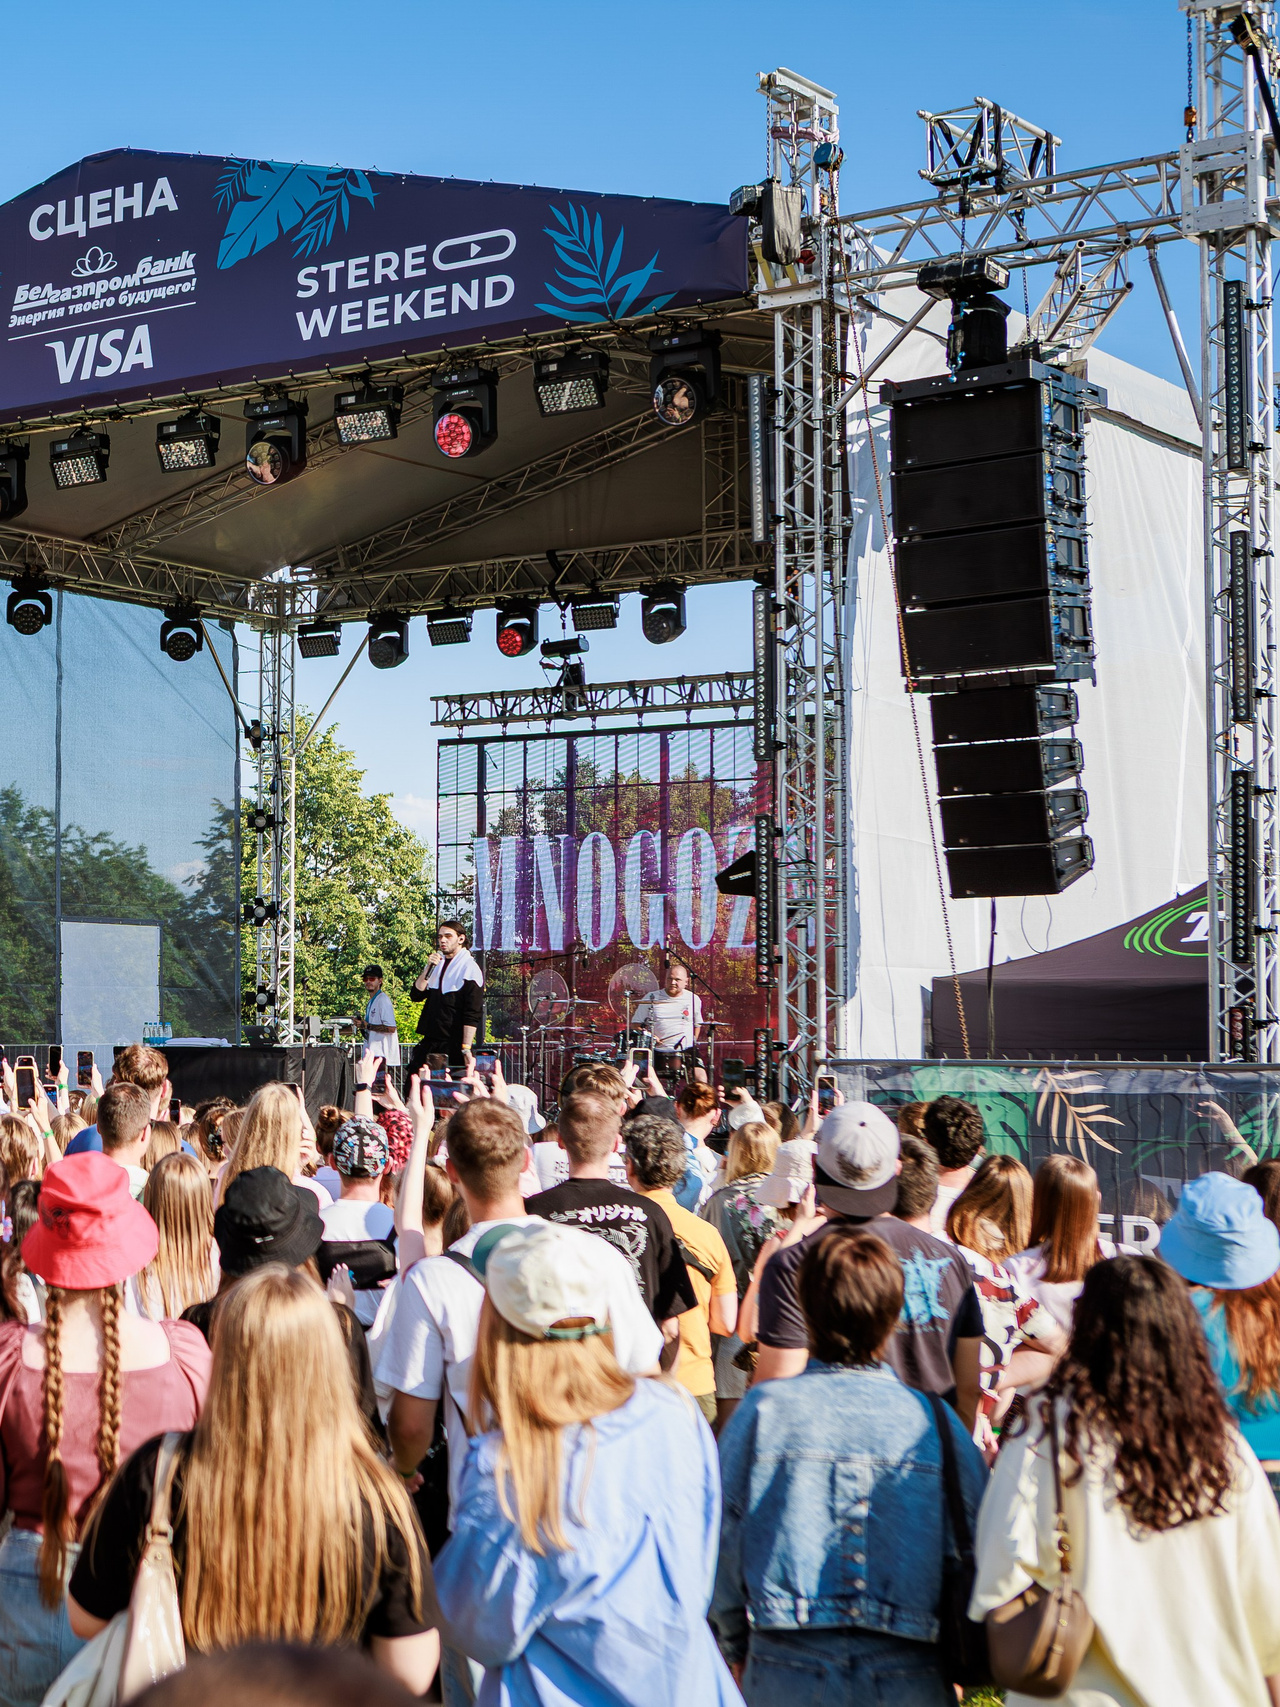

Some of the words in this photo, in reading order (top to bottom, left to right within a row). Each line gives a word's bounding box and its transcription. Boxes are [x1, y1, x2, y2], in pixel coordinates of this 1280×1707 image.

[28, 176, 179, 241] СЦЕНА
[8, 306, 65, 328] Энергия
[68, 296, 115, 315] твоего
[118, 278, 197, 307] будущего!
[13, 250, 197, 305] Белгазпромбанк
[295, 274, 516, 341] WEEKEND
[44, 323, 153, 384] VISA
[577, 1203, 648, 1223] オリジナル
